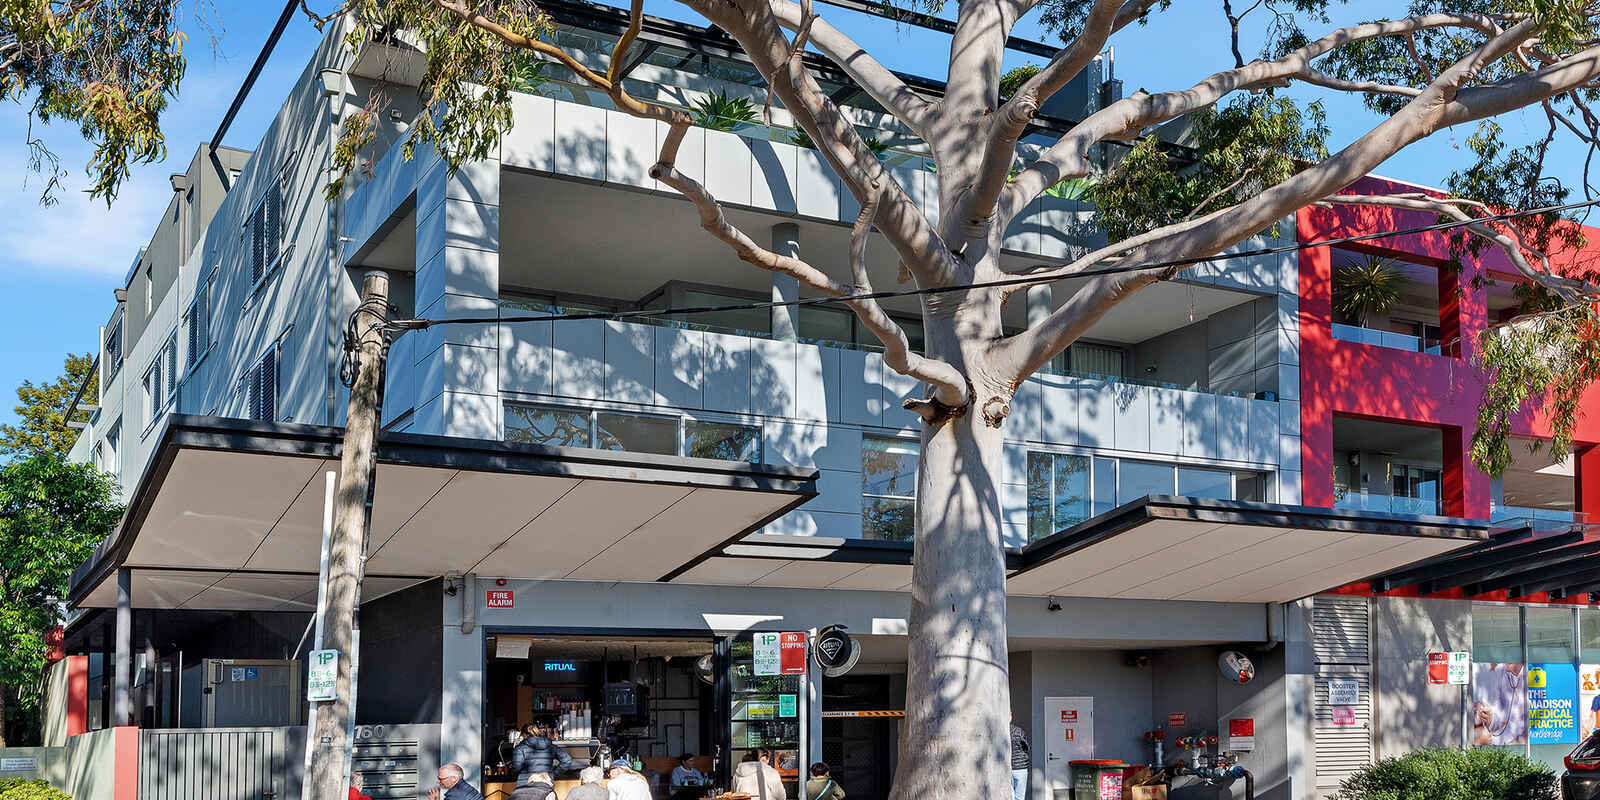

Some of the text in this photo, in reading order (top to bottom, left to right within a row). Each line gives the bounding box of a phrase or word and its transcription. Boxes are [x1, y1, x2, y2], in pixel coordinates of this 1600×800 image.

[761, 634, 776, 645] 1P
[318, 652, 334, 664] 1P
[1455, 653, 1467, 661] 1P
[1528, 690, 1546, 698] THE
[1528, 700, 1571, 708] MADISON
[1529, 709, 1573, 718] MEDICAL
[1529, 719, 1574, 728] PRACTICE
[355, 725, 385, 739] 160
